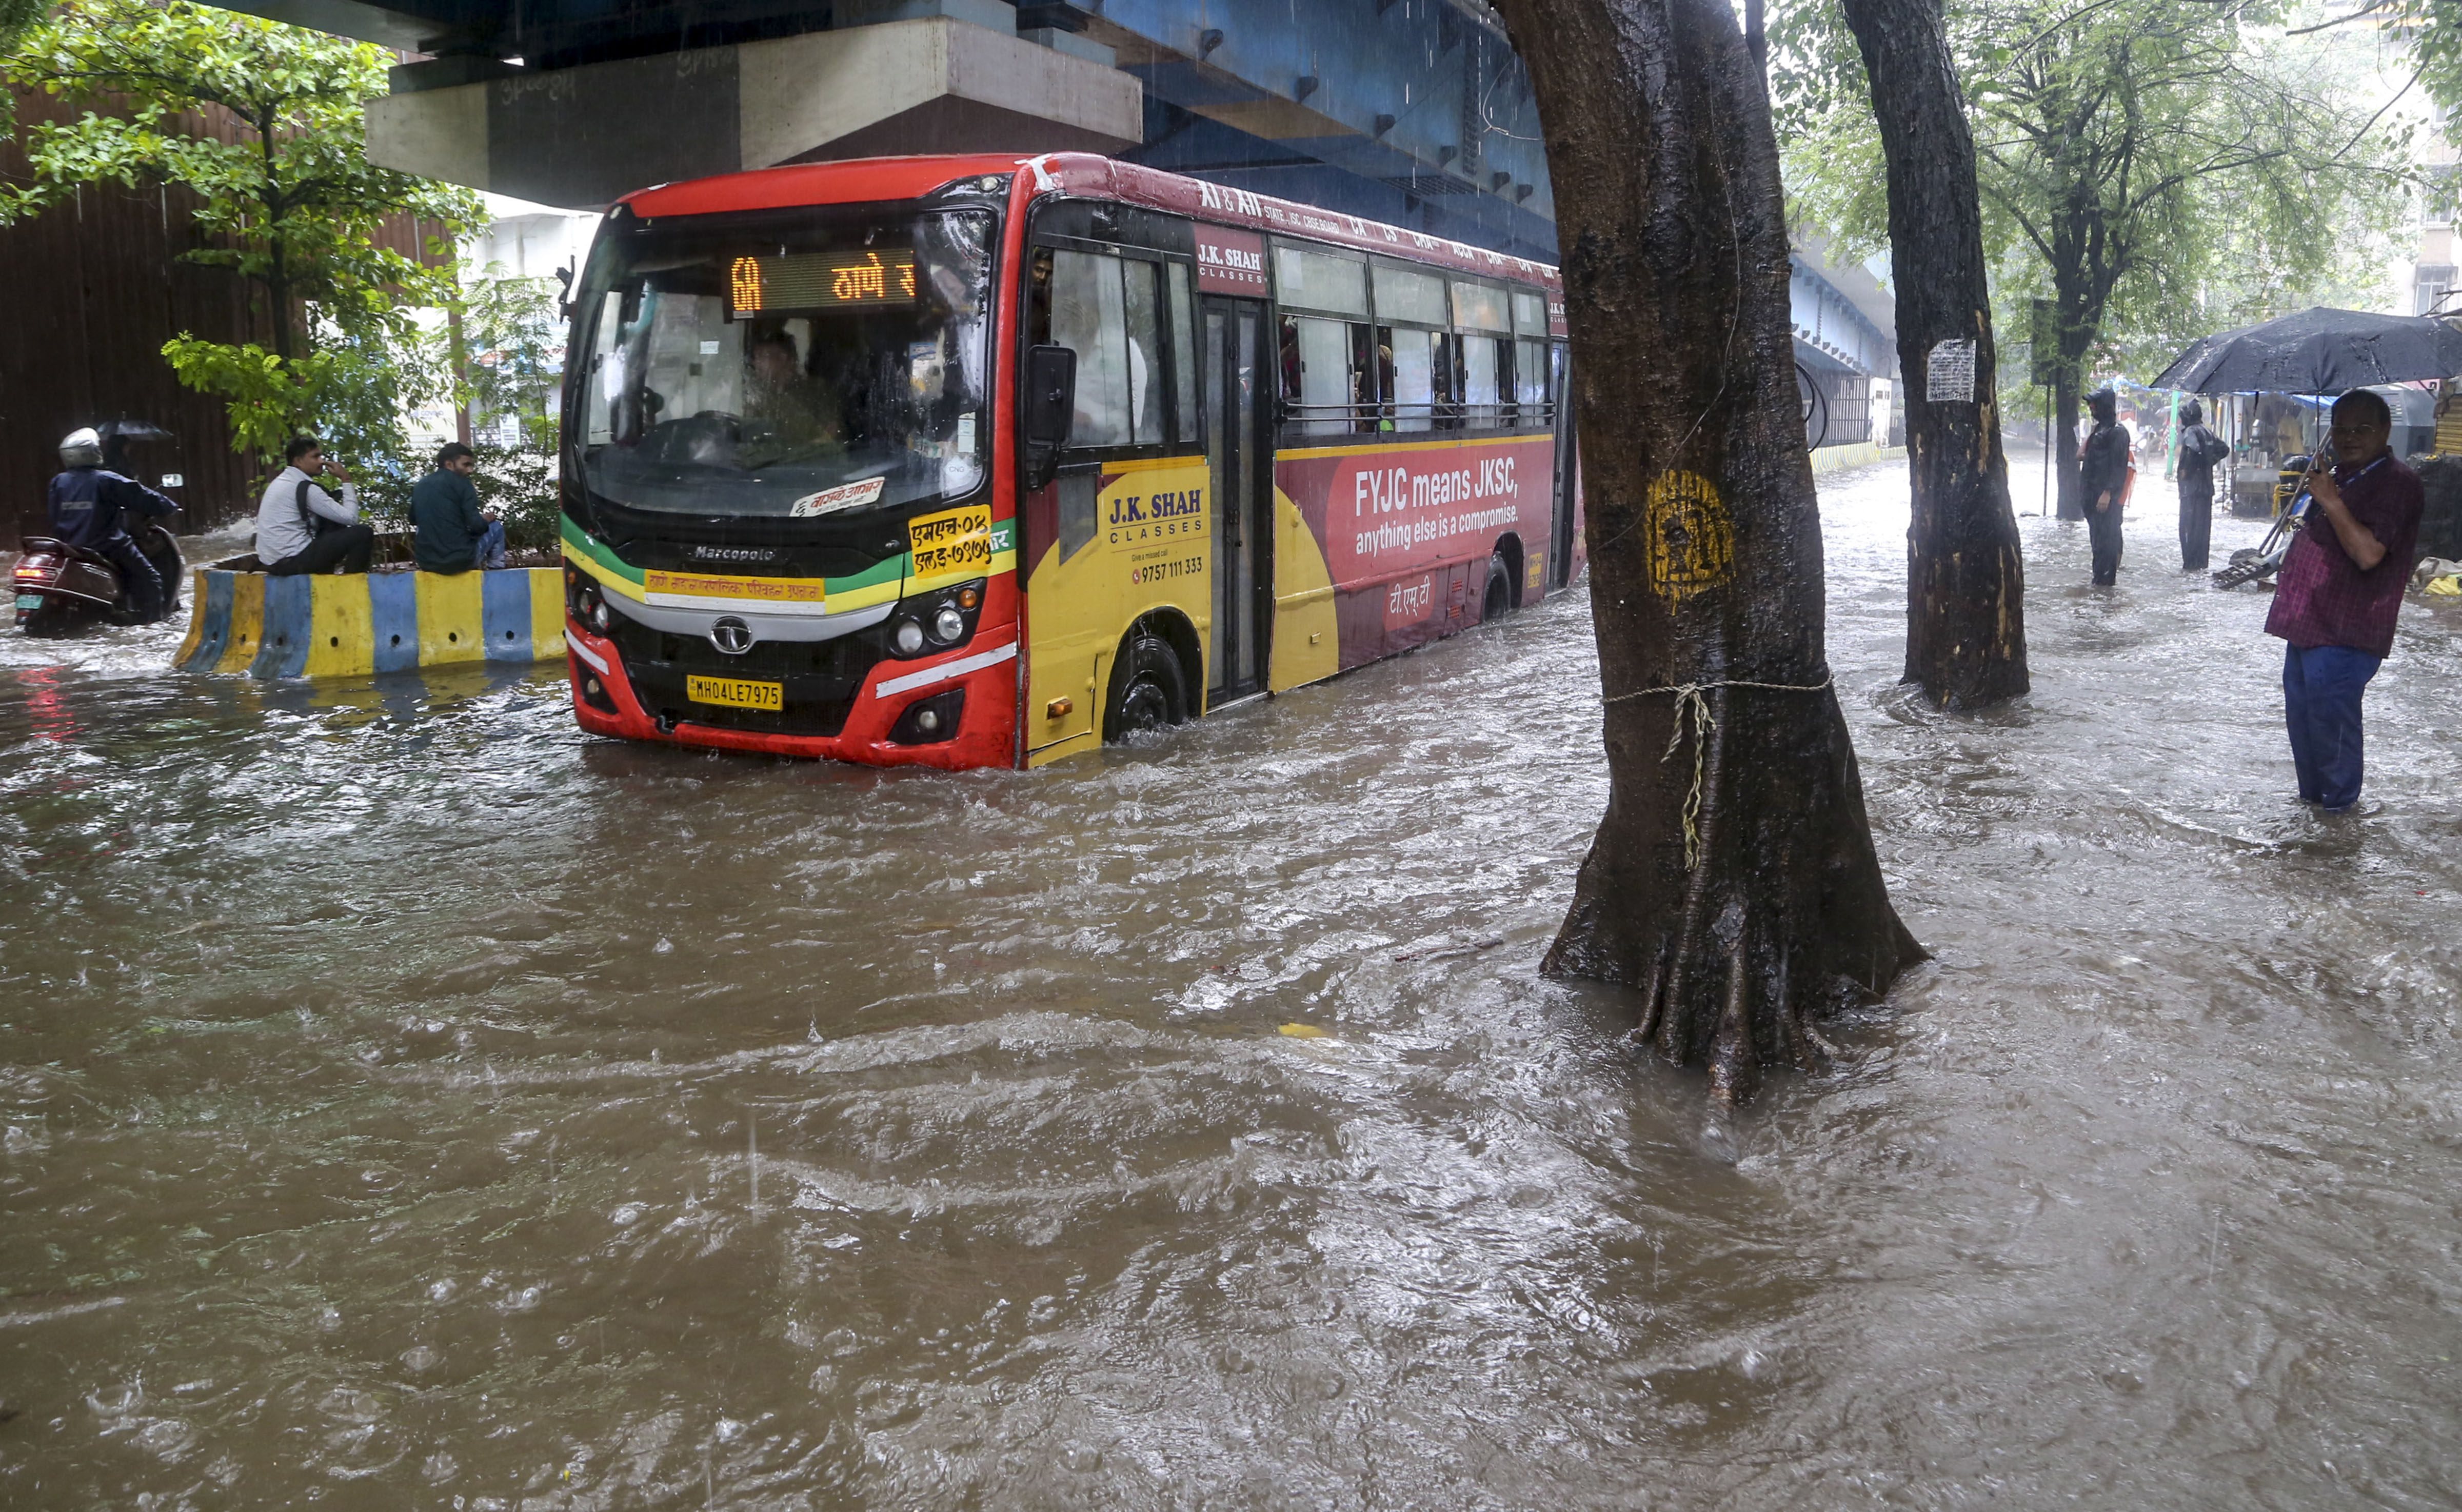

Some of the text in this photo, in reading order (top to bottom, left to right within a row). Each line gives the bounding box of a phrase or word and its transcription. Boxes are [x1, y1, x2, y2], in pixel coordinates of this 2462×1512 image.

[1223, 189, 1234, 211] &
[1349, 215, 1366, 236] CA
[1199, 244, 1261, 270] J.K. SHAH
[831, 253, 885, 299] ठाणे
[1200, 267, 1262, 283] CLASSES
[1356, 456, 1518, 516] FYJC means JKSC,
[1110, 490, 1201, 524] J.K. SHAH
[1110, 520, 1201, 544] CLASSES
[1356, 501, 1518, 558] anything else is a compromise.
[695, 546, 775, 561] Marcopolo
[1131, 553, 1141, 562] Give
[1145, 550, 1160, 559] missed
[1142, 557, 1202, 583] 9757 111 333
[697, 681, 779, 705] MH04LE7975
